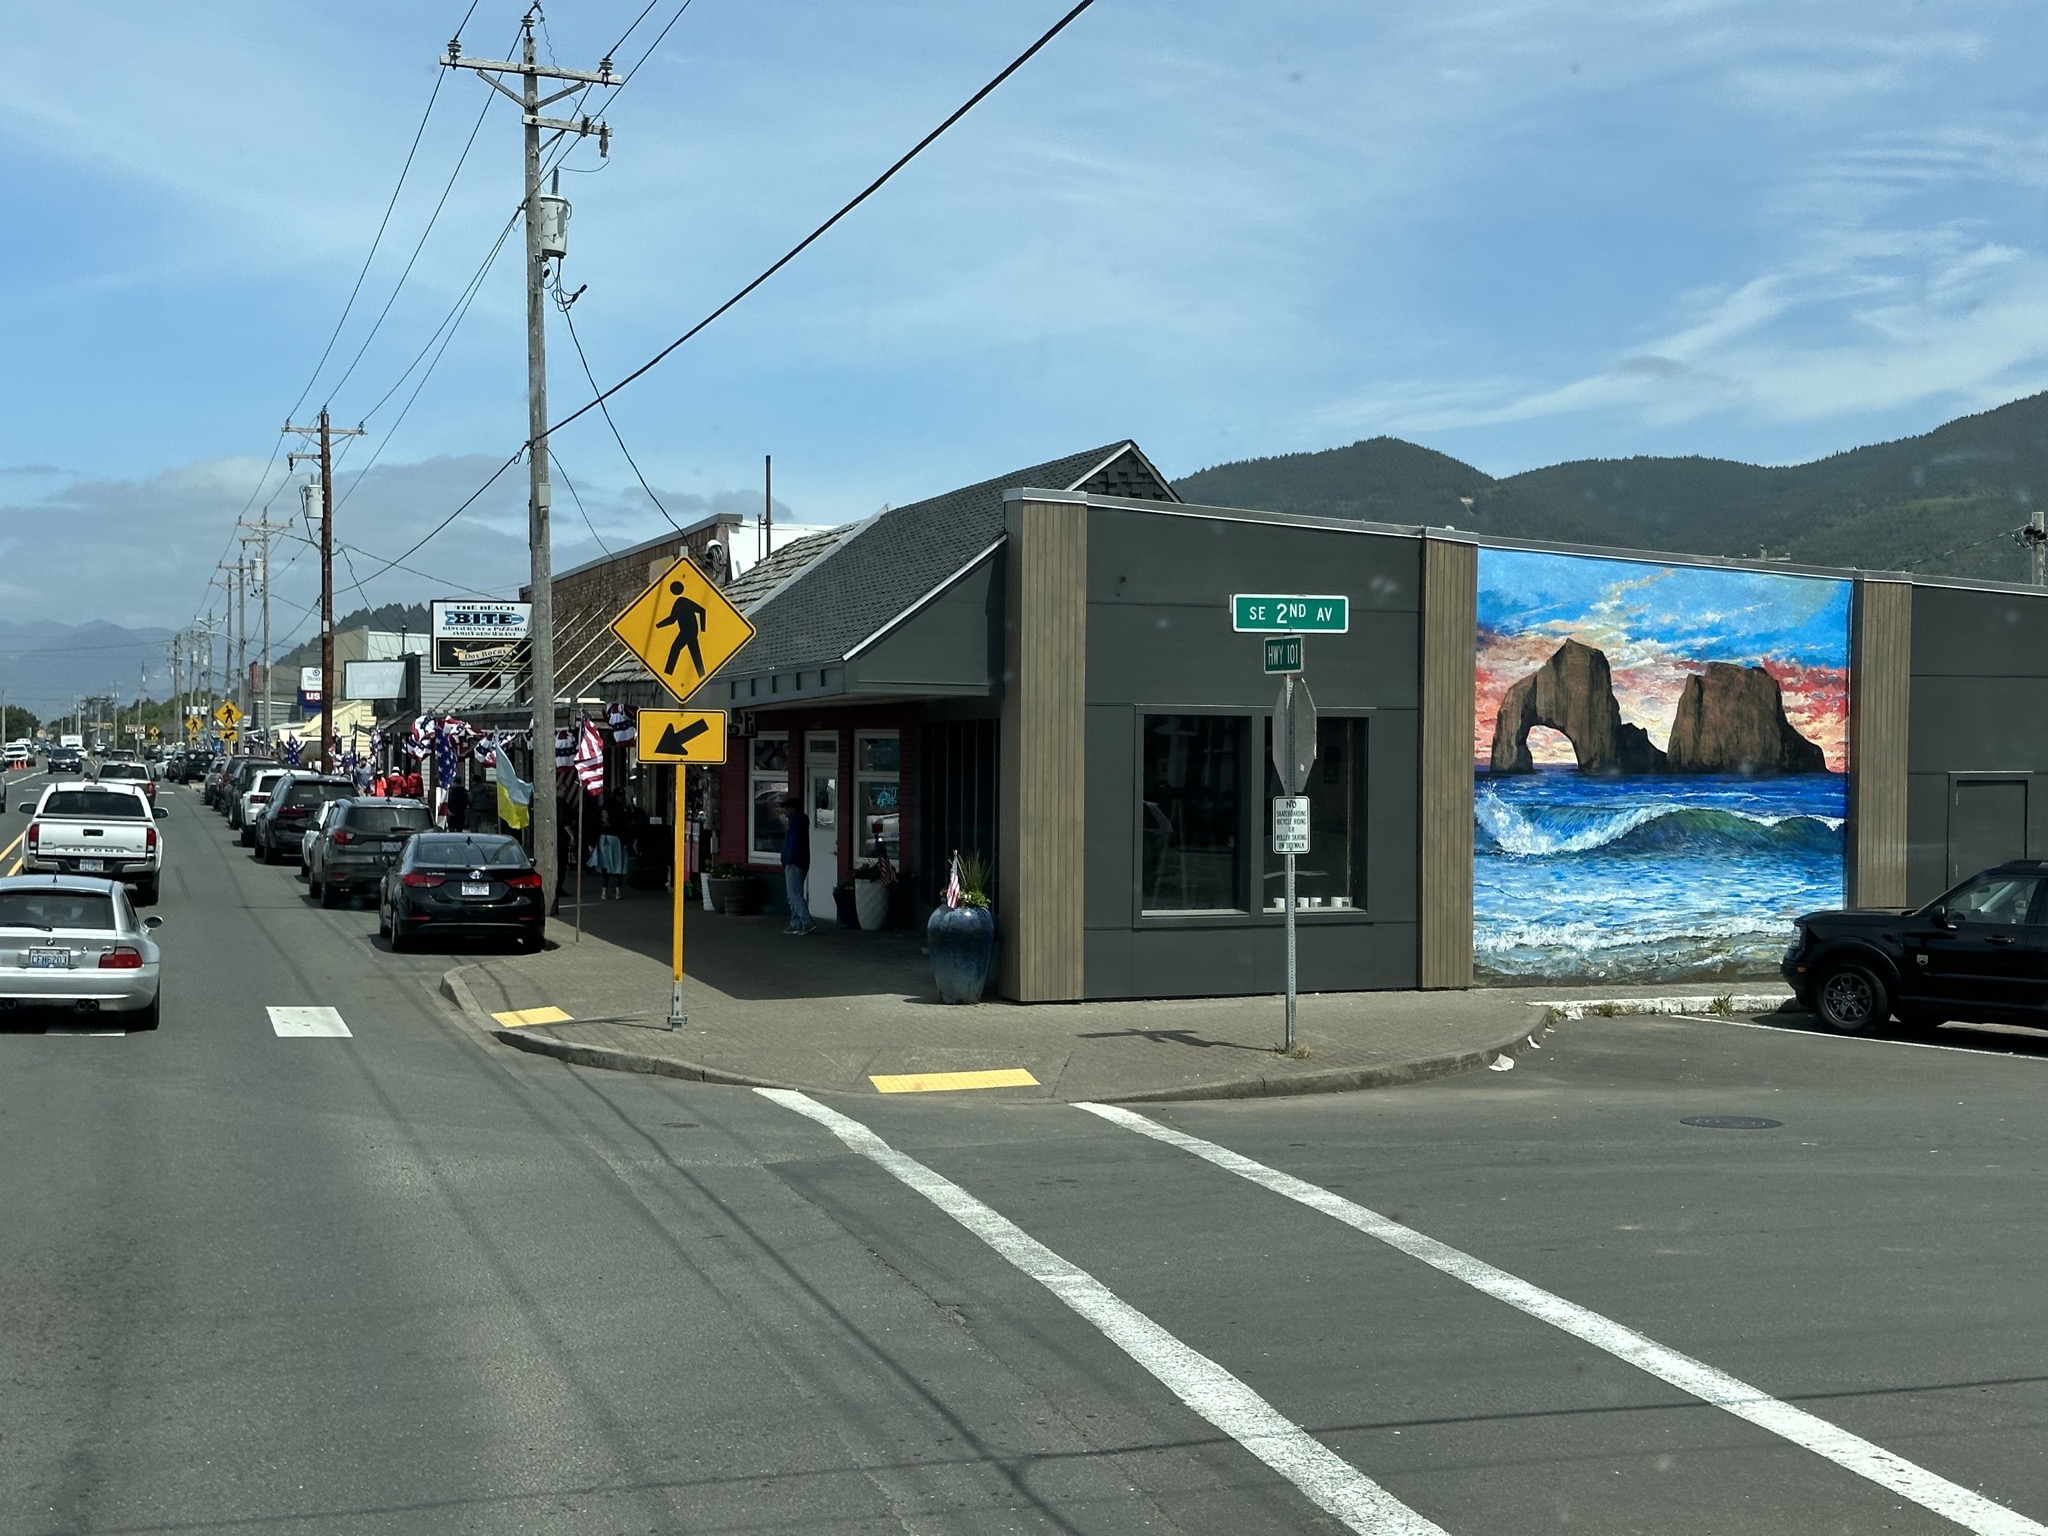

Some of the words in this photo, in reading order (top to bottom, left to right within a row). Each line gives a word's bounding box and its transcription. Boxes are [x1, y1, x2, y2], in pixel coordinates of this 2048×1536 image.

[454, 613, 512, 624] BITE
[1249, 606, 1266, 620] SE
[1276, 603, 1306, 624] 2ND
[1316, 607, 1332, 621] AV
[1268, 645, 1284, 665] HWY
[1287, 643, 1298, 664] 101
[1286, 800, 1297, 808] NO
